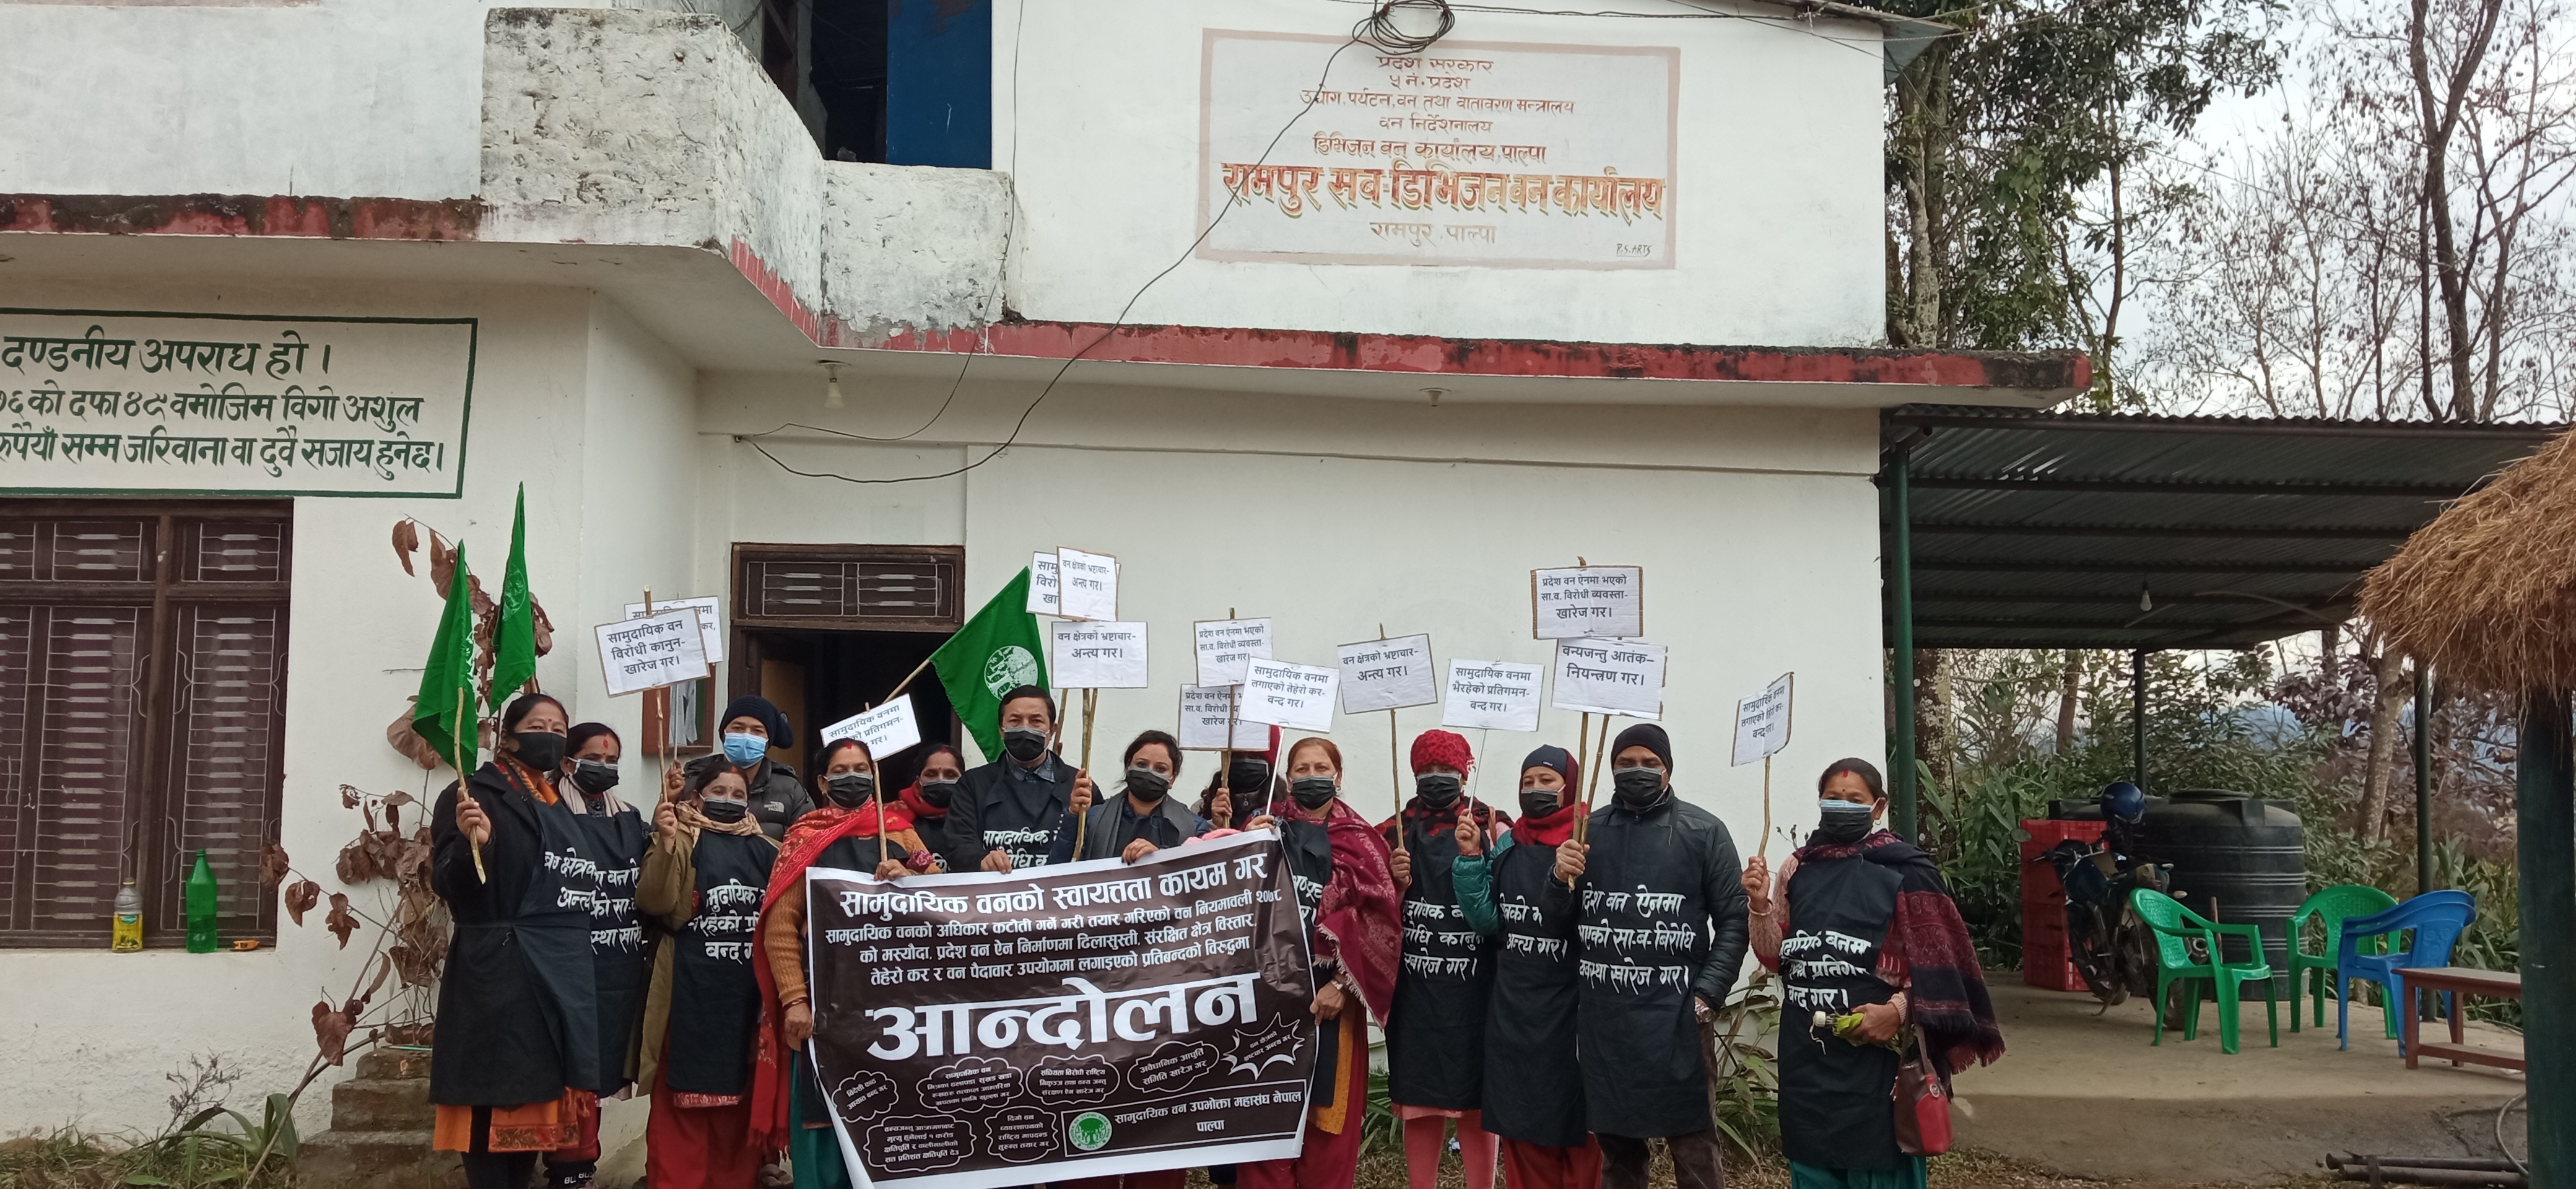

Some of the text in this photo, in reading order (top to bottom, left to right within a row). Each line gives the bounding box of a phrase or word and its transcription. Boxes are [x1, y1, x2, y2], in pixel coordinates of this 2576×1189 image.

[1424, 95, 1451, 111] तथा
[1380, 116, 1404, 129] वन
[1221, 162, 1325, 219] रामपुर
[1552, 166, 1666, 227] कार्यालय
[1, 324, 136, 376] दण्डनीय
[139, 339, 261, 377] अपराध
[69, 390, 121, 422] दफा
[281, 385, 340, 421] विगो
[343, 395, 425, 433] अशुल
[61, 434, 123, 464] सम्म
[123, 425, 230, 466] जरिवाना
[230, 437, 258, 467] वा
[259, 425, 298, 477] दुवै
[302, 438, 375, 470] सजाय
[1543, 576, 1561, 586] प्रदेश
[1564, 577, 1576, 585] वन
[1602, 574, 1627, 585] भएको
[1556, 604, 1588, 619] खारेज
[606, 619, 683, 643] सामुदायिक वन
[611, 642, 647, 660] विरोधी
[1071, 647, 1099, 658] अन्त्य
[1216, 652, 1236, 663] खारेज
[1562, 645, 1608, 663] वन्यजन्तु
[624, 659, 657, 674] खारेज
[1342, 655, 1354, 665] वन
[1254, 665, 1329, 684] सामुदायिक वनमा
[1357, 668, 1384, 682] अन्त्य
[1455, 666, 1531, 681] सामुदायिक वनमा
[1251, 678, 1284, 692] लगाएको
[876, 704, 900, 719] वनमा
[1202, 715, 1225, 725] खारेज
[840, 890, 968, 921] सामुदायिक
[976, 884, 1045, 914] वनको
[1158, 861, 1227, 897] कायम
[1233, 853, 1268, 880] गर
[825, 923, 892, 946] सामुदायिक
[895, 921, 933, 939] वनको
[936, 920, 989, 938] अधिकार
[992, 918, 1032, 934] कटौती
[1061, 915, 1084, 929] गरी
[1087, 913, 1120, 928] तयार
[1124, 905, 1170, 924] गरिएको
[1174, 907, 1192, 920] वन
[1195, 890, 1252, 917] नियमावली
[859, 946, 878, 964] को
[936, 942, 967, 960] प्रदेश
[970, 944, 990, 957] वन
[994, 939, 1013, 957] ऐन
[1017, 936, 1073, 954] निर्माणमा
[871, 966, 903, 985] तेहेरो
[907, 967, 929, 982] कर
[933, 967, 943, 981] र
[947, 966, 966, 980] वन
[970, 962, 1013, 979] पैदावार
[1017, 957, 1074, 976] उपयोगमा
[1078, 950, 1138, 971] लगाइएको
[865, 972, 1261, 1060] आन्दोलन
[1115, 1107, 1168, 1124] सामुदायिक
[1172, 1104, 1186, 1114] वन
[1234, 1093, 1269, 1107] महासंघ
[1273, 1090, 1302, 1104] नेपाल
[1196, 1120, 1225, 1133] पाल्पा
